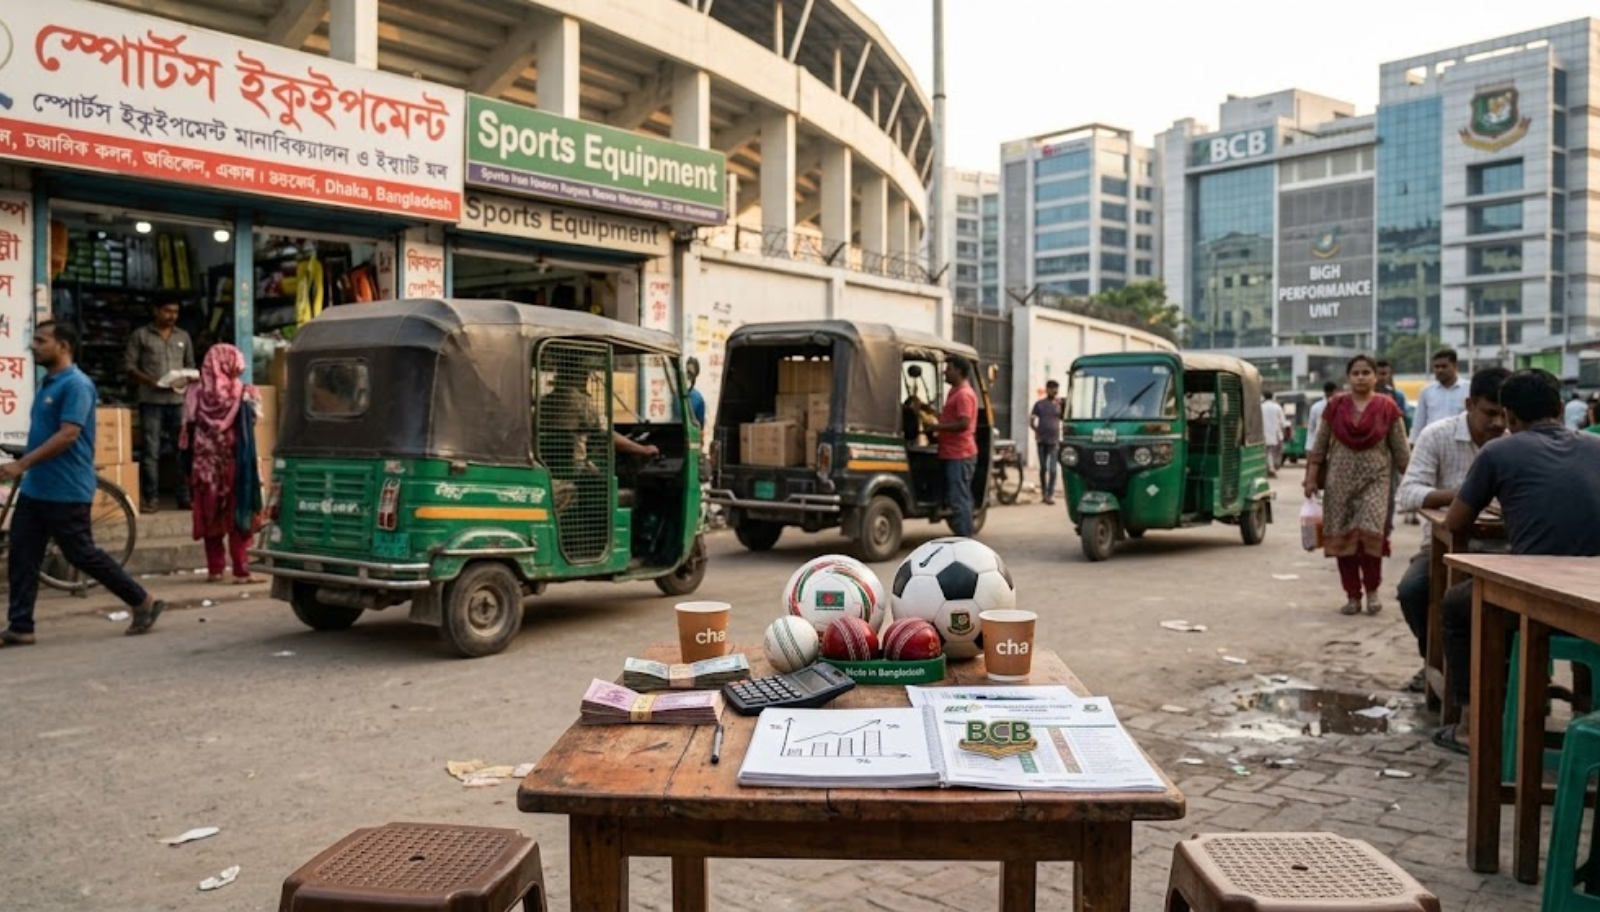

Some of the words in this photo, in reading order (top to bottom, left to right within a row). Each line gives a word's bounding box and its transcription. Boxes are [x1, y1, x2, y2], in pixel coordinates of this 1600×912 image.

[35, 24, 222, 102] স্পোর্টস
[234, 50, 450, 141] ইকুইপমেন্ট
[33, 93, 113, 124] স্পোর্টস
[119, 101, 228, 141] ইকুইপমেন্ট
[357, 151, 369, 167] ও
[1210, 130, 1267, 163] BCB
[478, 109, 576, 164] Sports
[584, 133, 718, 193] Equipment
[325, 178, 373, 203] Dhaka,
[376, 186, 453, 212] Bangladesh
[465, 195, 542, 229] Sports
[550, 209, 660, 246] Equipment
[1279, 279, 1371, 300] PERFORMANCE
[1309, 301, 1340, 318] UNIT
[695, 627, 726, 645] cha
[996, 638, 1030, 655] cha
[965, 720, 1032, 743] BCB
